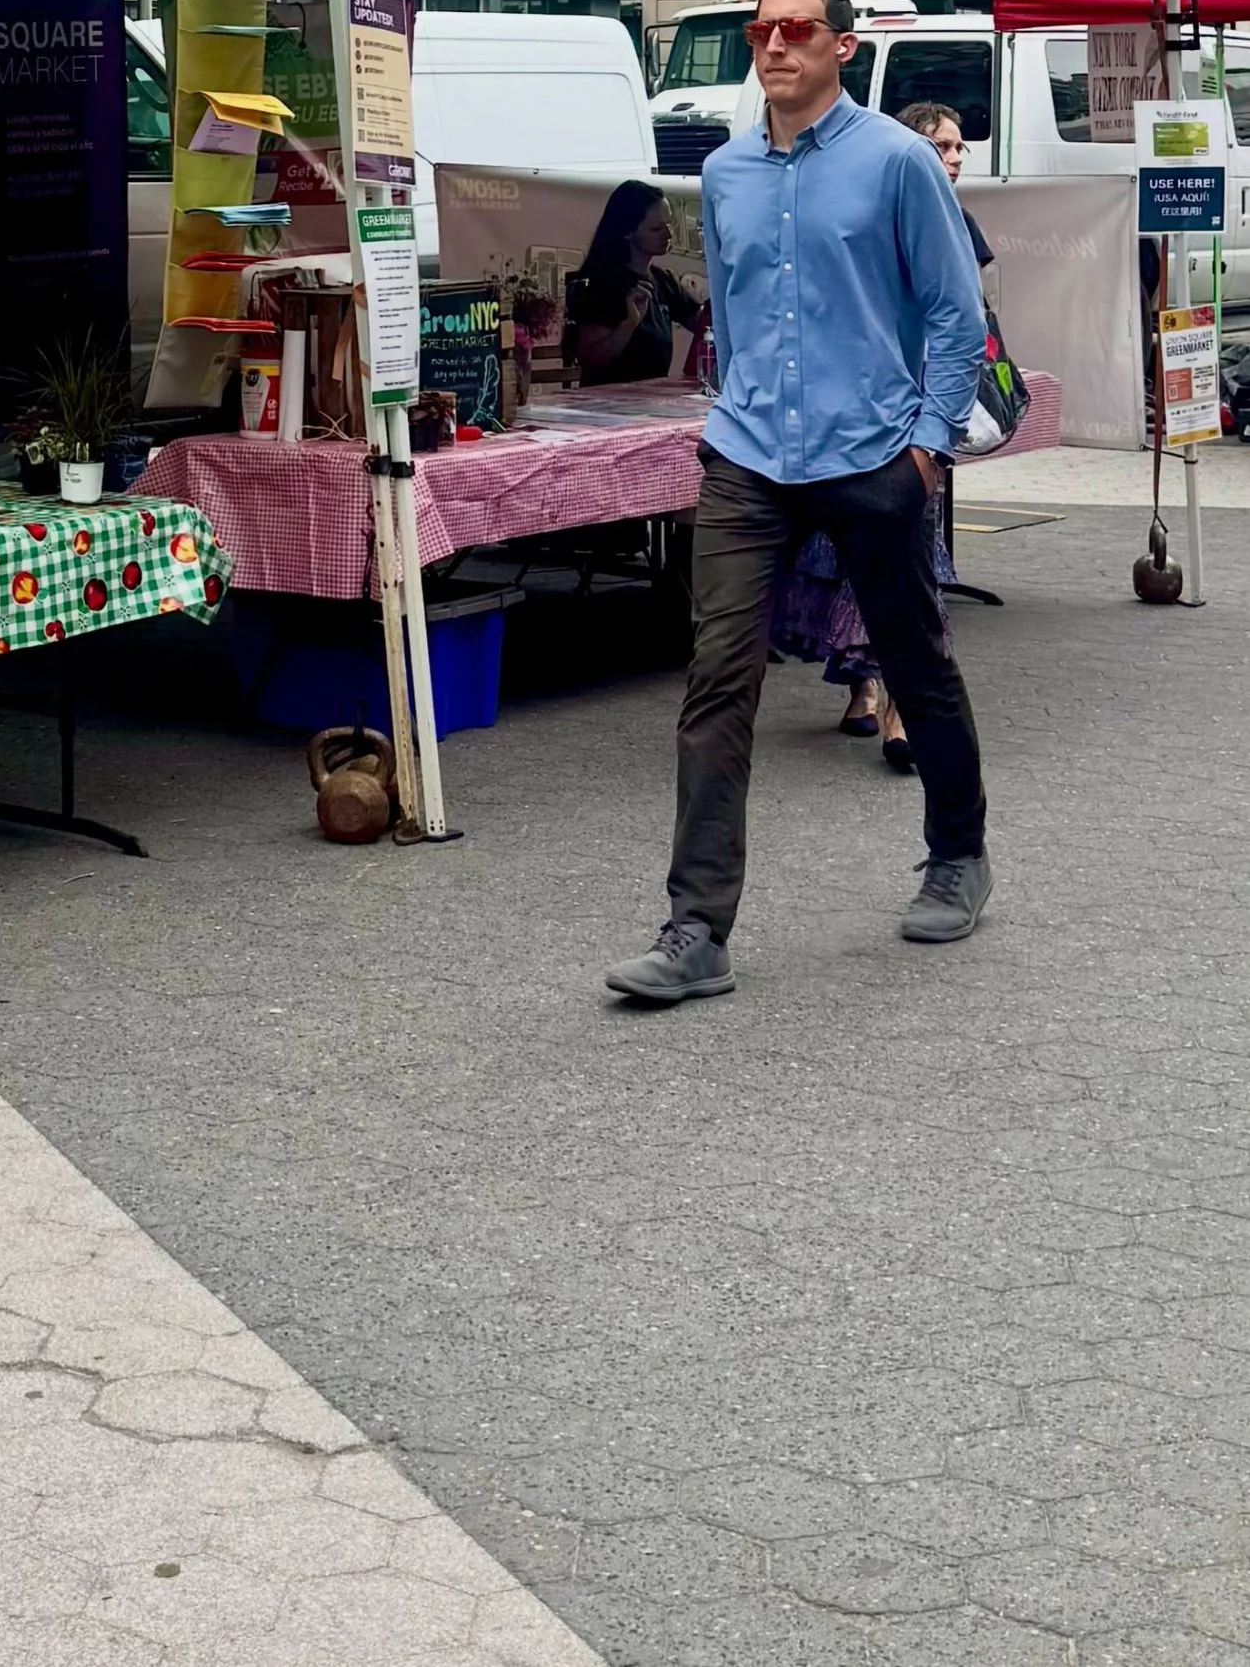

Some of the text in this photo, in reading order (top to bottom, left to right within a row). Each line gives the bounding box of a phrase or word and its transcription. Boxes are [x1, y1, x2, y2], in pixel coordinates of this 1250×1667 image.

[354, 8, 395, 27] UPDATED!
[1113, 32, 1138, 68] YORK
[287, 164, 311, 179] Get
[278, 181, 314, 192] Recibe
[1149, 178, 1215, 189] USE HERE!
[1154, 191, 1210, 202] ¡USA AQUÍ!
[1166, 339, 1213, 357] GREENMARKET
